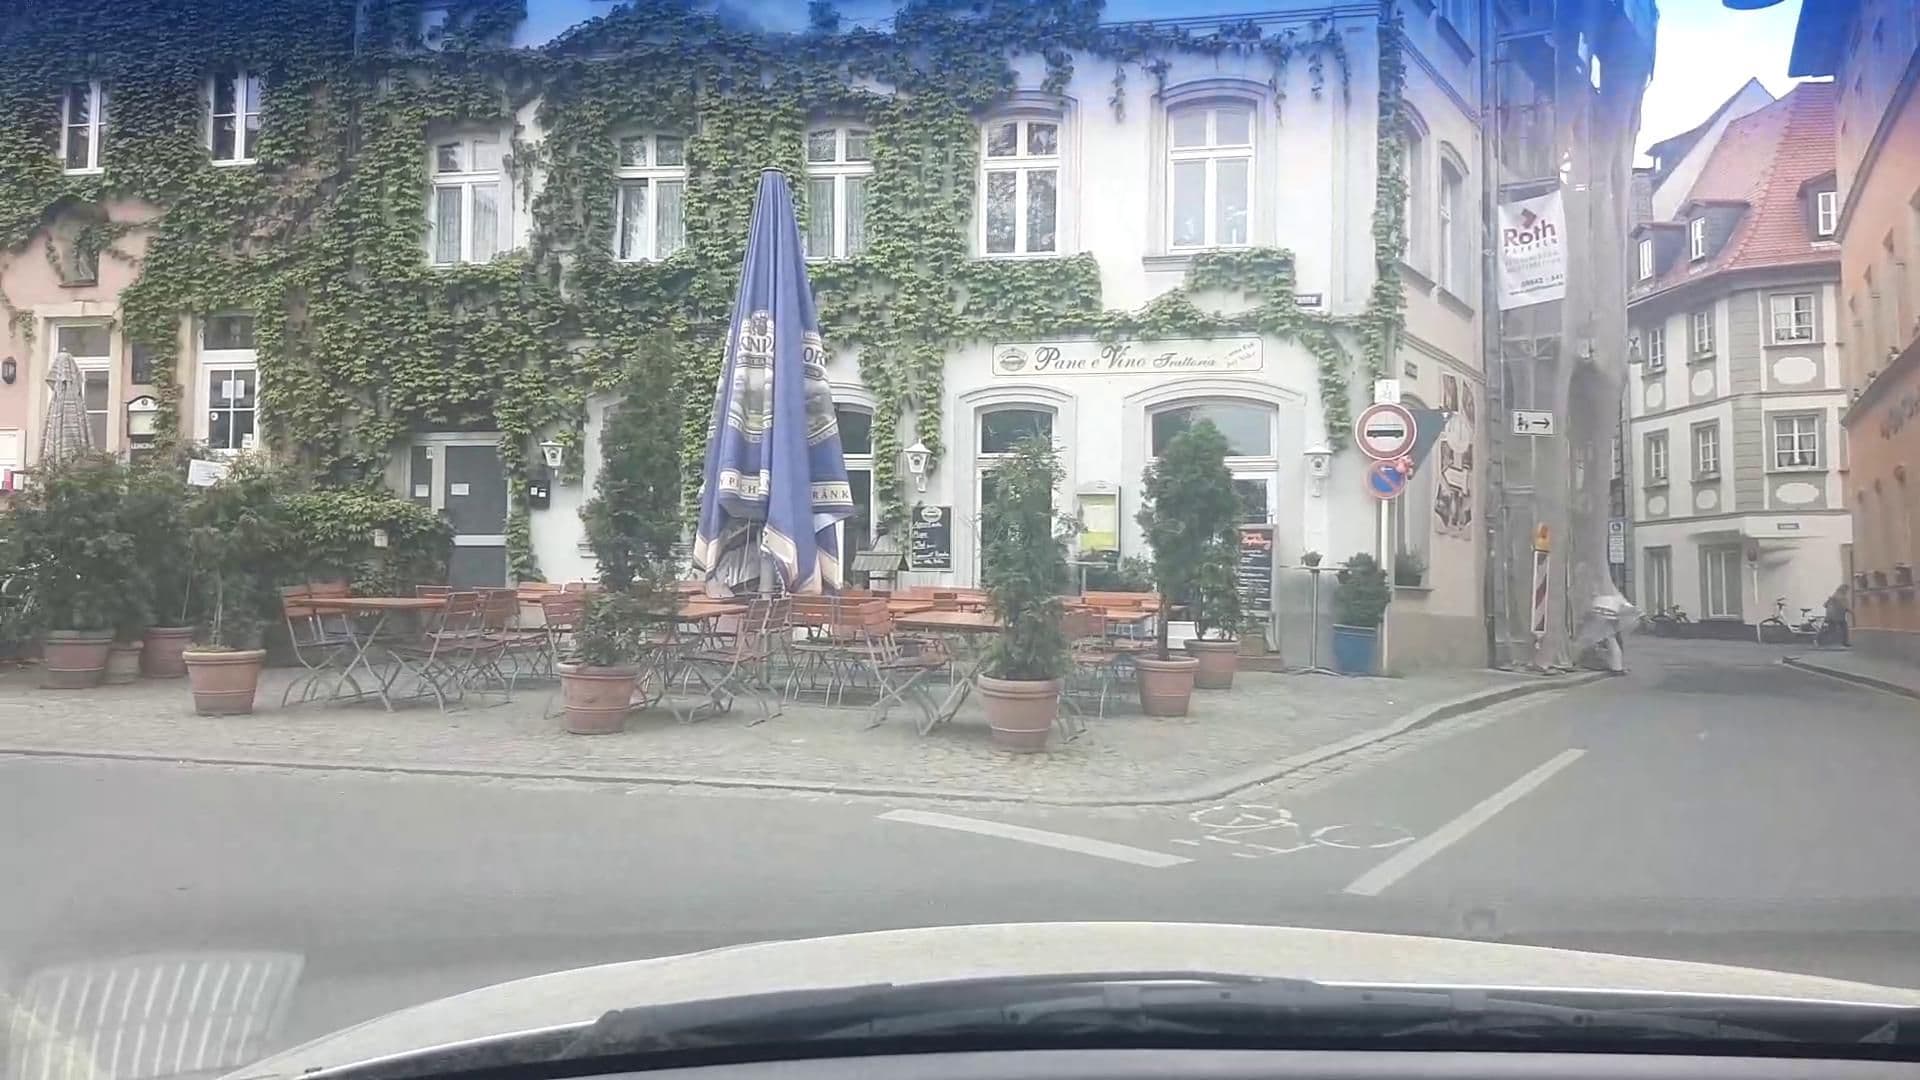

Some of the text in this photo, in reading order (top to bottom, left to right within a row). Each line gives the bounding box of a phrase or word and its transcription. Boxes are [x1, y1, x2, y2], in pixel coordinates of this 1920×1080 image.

[1503, 219, 1556, 247] Roth
[1035, 346, 1086, 371] Pane
[1100, 345, 1148, 369] Vino
[1153, 352, 1218, 368] Trattoria
